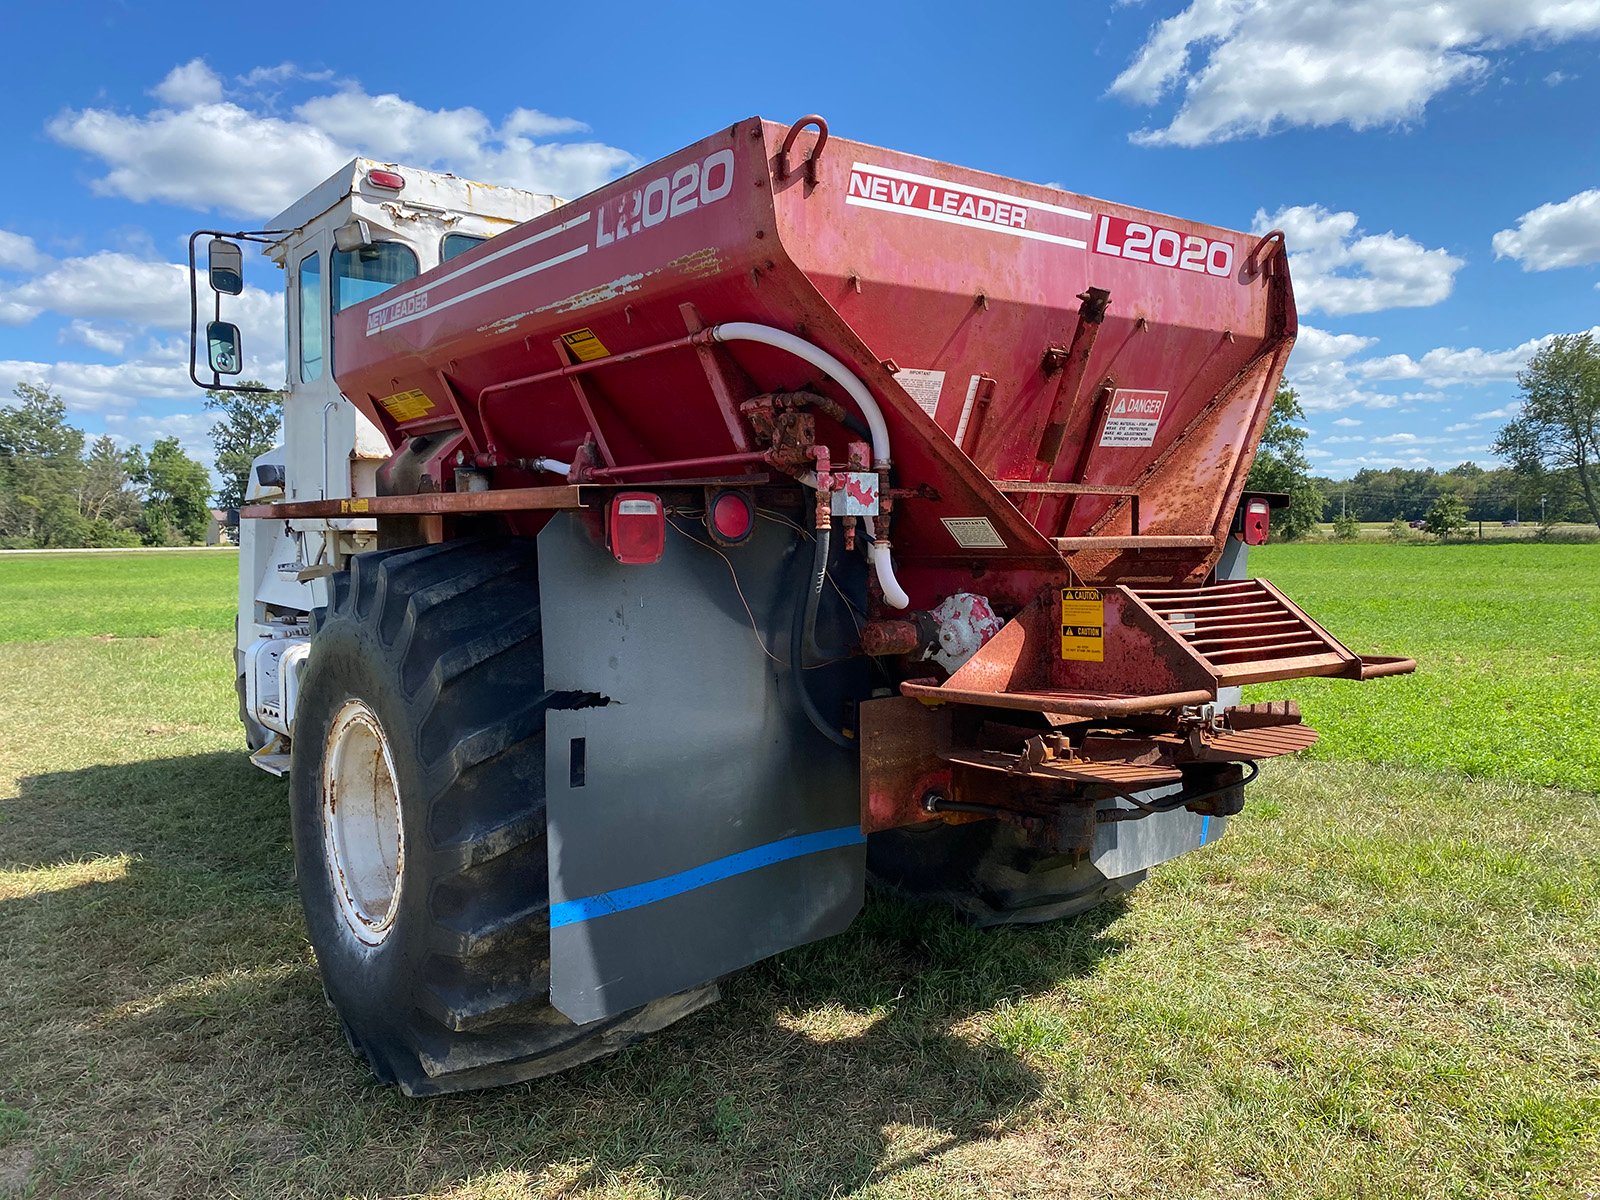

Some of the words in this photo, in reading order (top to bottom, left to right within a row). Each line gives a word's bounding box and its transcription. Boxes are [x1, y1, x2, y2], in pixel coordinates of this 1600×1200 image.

[848, 172, 918, 206] NEW
[927, 188, 1028, 228] LEADER
[1097, 215, 1233, 277] L2020
[366, 308, 389, 329] NEW
[390, 292, 428, 321] LEADER
[1127, 399, 1162, 414] DANGER
[1074, 591, 1100, 600] CAUTION
[1077, 627, 1100, 636] CAUTION
